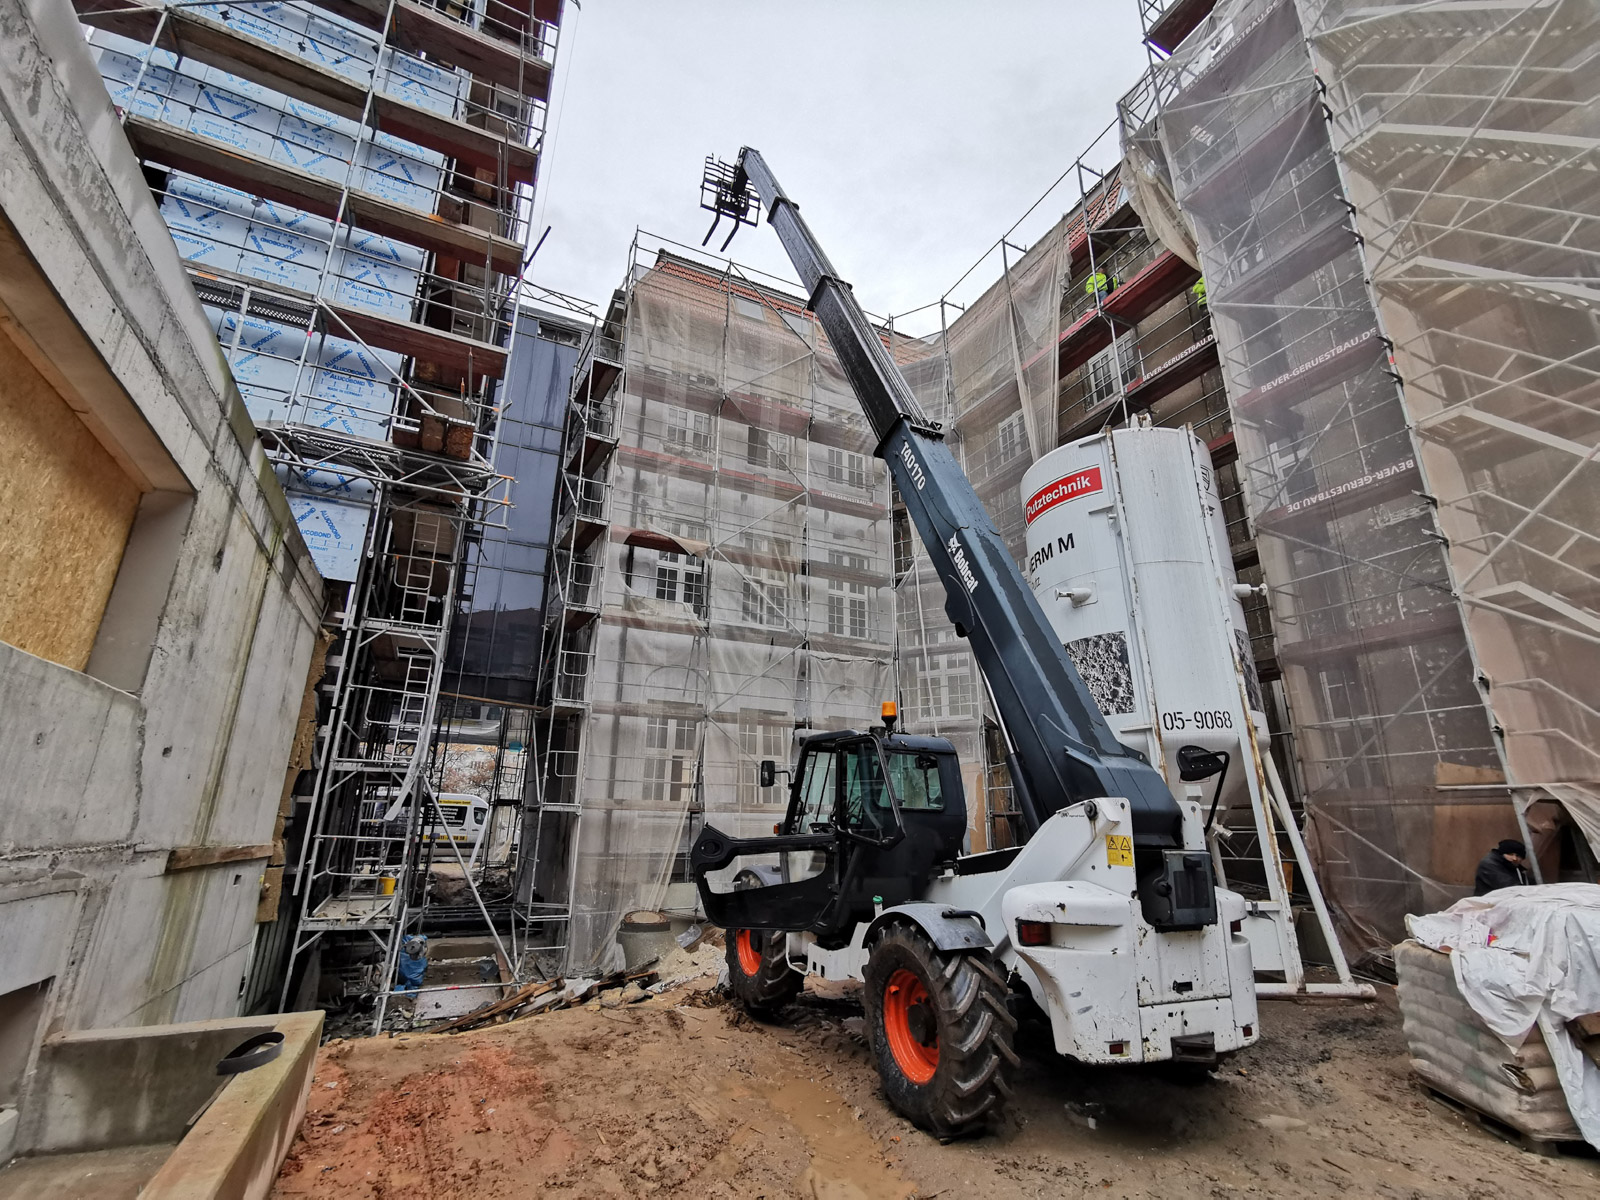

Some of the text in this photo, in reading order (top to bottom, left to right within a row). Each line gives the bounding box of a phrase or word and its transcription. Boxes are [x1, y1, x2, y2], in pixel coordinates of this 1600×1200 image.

[171, 232, 208, 247] ALUCOBON
[260, 237, 297, 251] ALUCOBOND
[360, 246, 394, 260] ALUCOBOND
[351, 284, 385, 298] ALUCOBOND
[243, 320, 274, 332] ALUCOBO
[251, 330, 282, 349] ALUCOBOND
[325, 348, 353, 367] ALUCOBOND
[357, 351, 376, 379] ALUCOBOND
[1142, 334, 1213, 382] BEVER-GERUESTBAU.D
[330, 373, 365, 386] ALUCOBOND
[332, 364, 367, 377] ALUCOBOND
[900, 441, 926, 491] T40170
[1286, 459, 1415, 513] BEVER-GERUESTBAU.DE
[1026, 475, 1091, 519] Putztechnik
[296, 507, 316, 525] COBOND
[320, 510, 342, 540] ALUCOBOND
[301, 529, 332, 539] UCOBOND
[1029, 532, 1075, 575] ERM M
[953, 548, 979, 594] Bobcat
[1162, 710, 1233, 731] 05-9068
